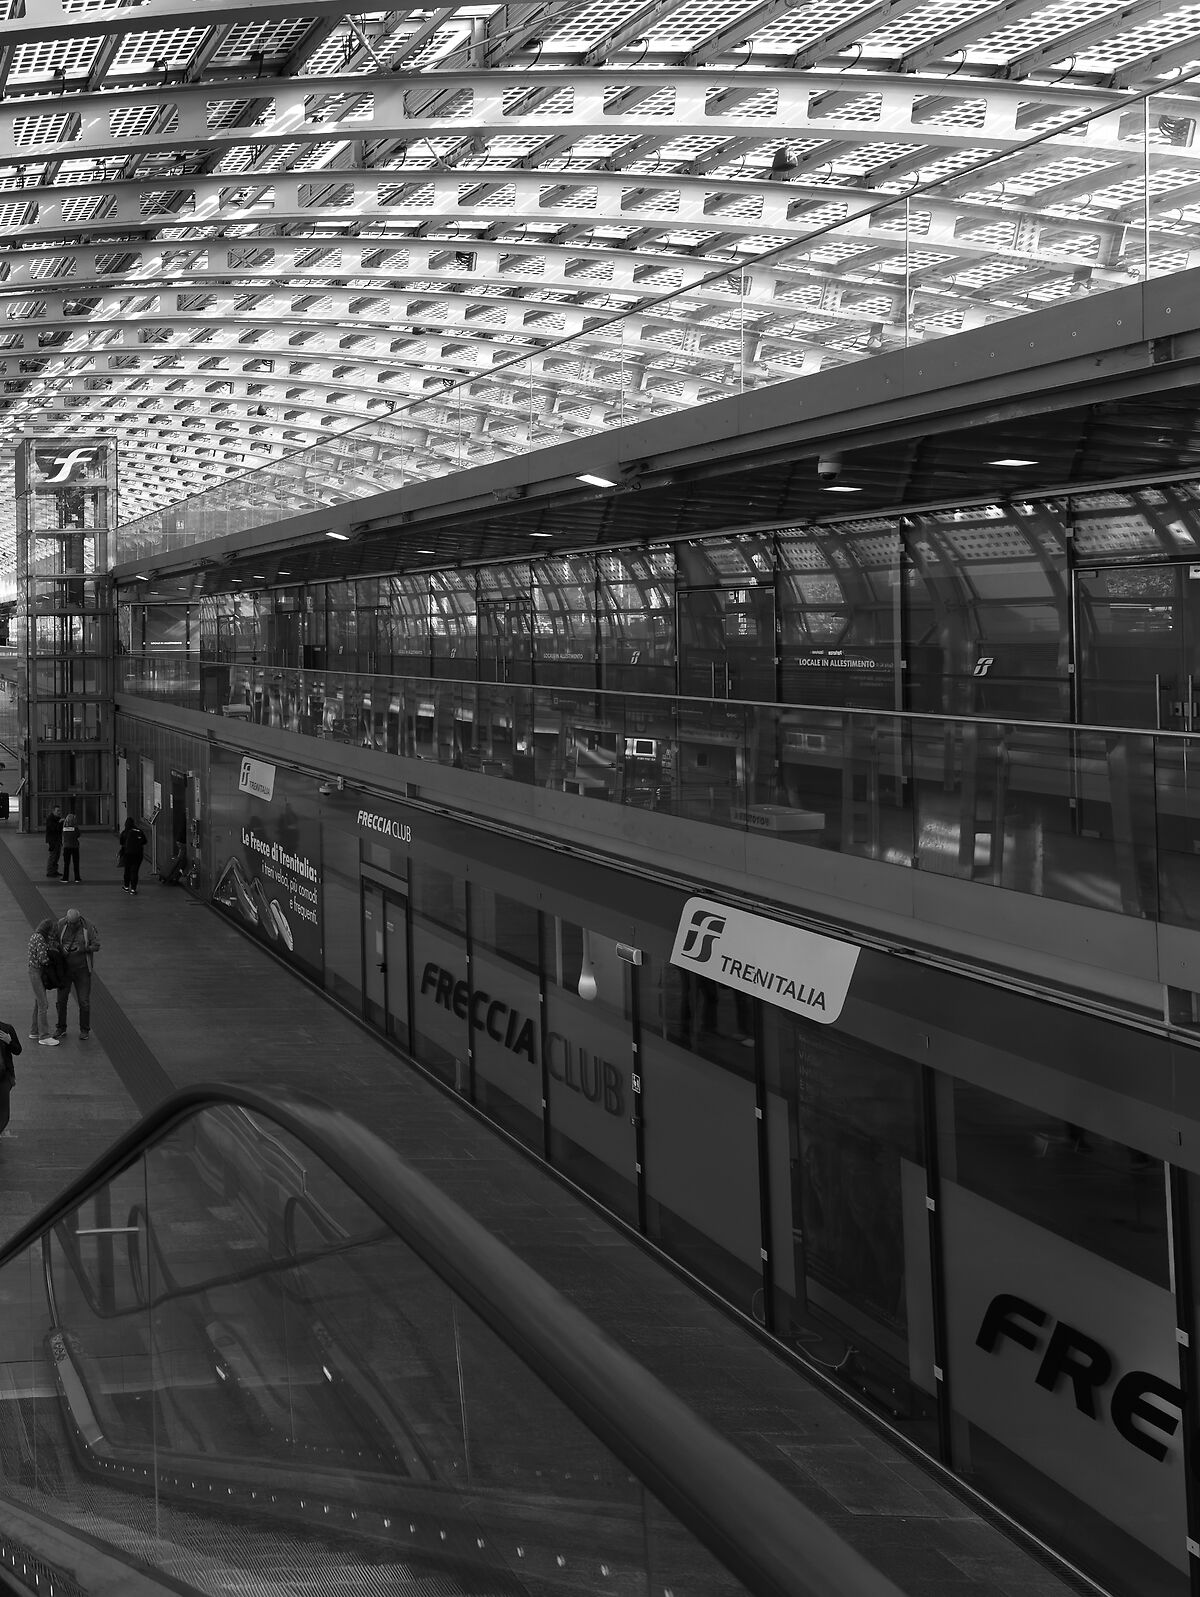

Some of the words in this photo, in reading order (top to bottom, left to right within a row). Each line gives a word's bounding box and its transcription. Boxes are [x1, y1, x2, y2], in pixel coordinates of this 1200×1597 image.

[799, 658, 821, 667] LOCALE
[821, 659, 829, 667] IN
[829, 659, 875, 668] ALLESTIMENTO
[242, 827, 250, 845] Le
[250, 831, 270, 858] Frecce
[271, 842, 279, 861] di
[279, 845, 318, 883] Trenitalia:
[265, 862, 275, 880] treni
[275, 869, 290, 891] veloci,
[289, 878, 298, 894] più
[298, 887, 318, 905] comodi
[293, 895, 318, 925] frequenti.
[721, 955, 826, 1011] TRENITALIA
[421, 962, 535, 1065] FRECCIA
[545, 1031, 625, 1117] CLUB
[976, 1293, 1188, 1463] FRE
